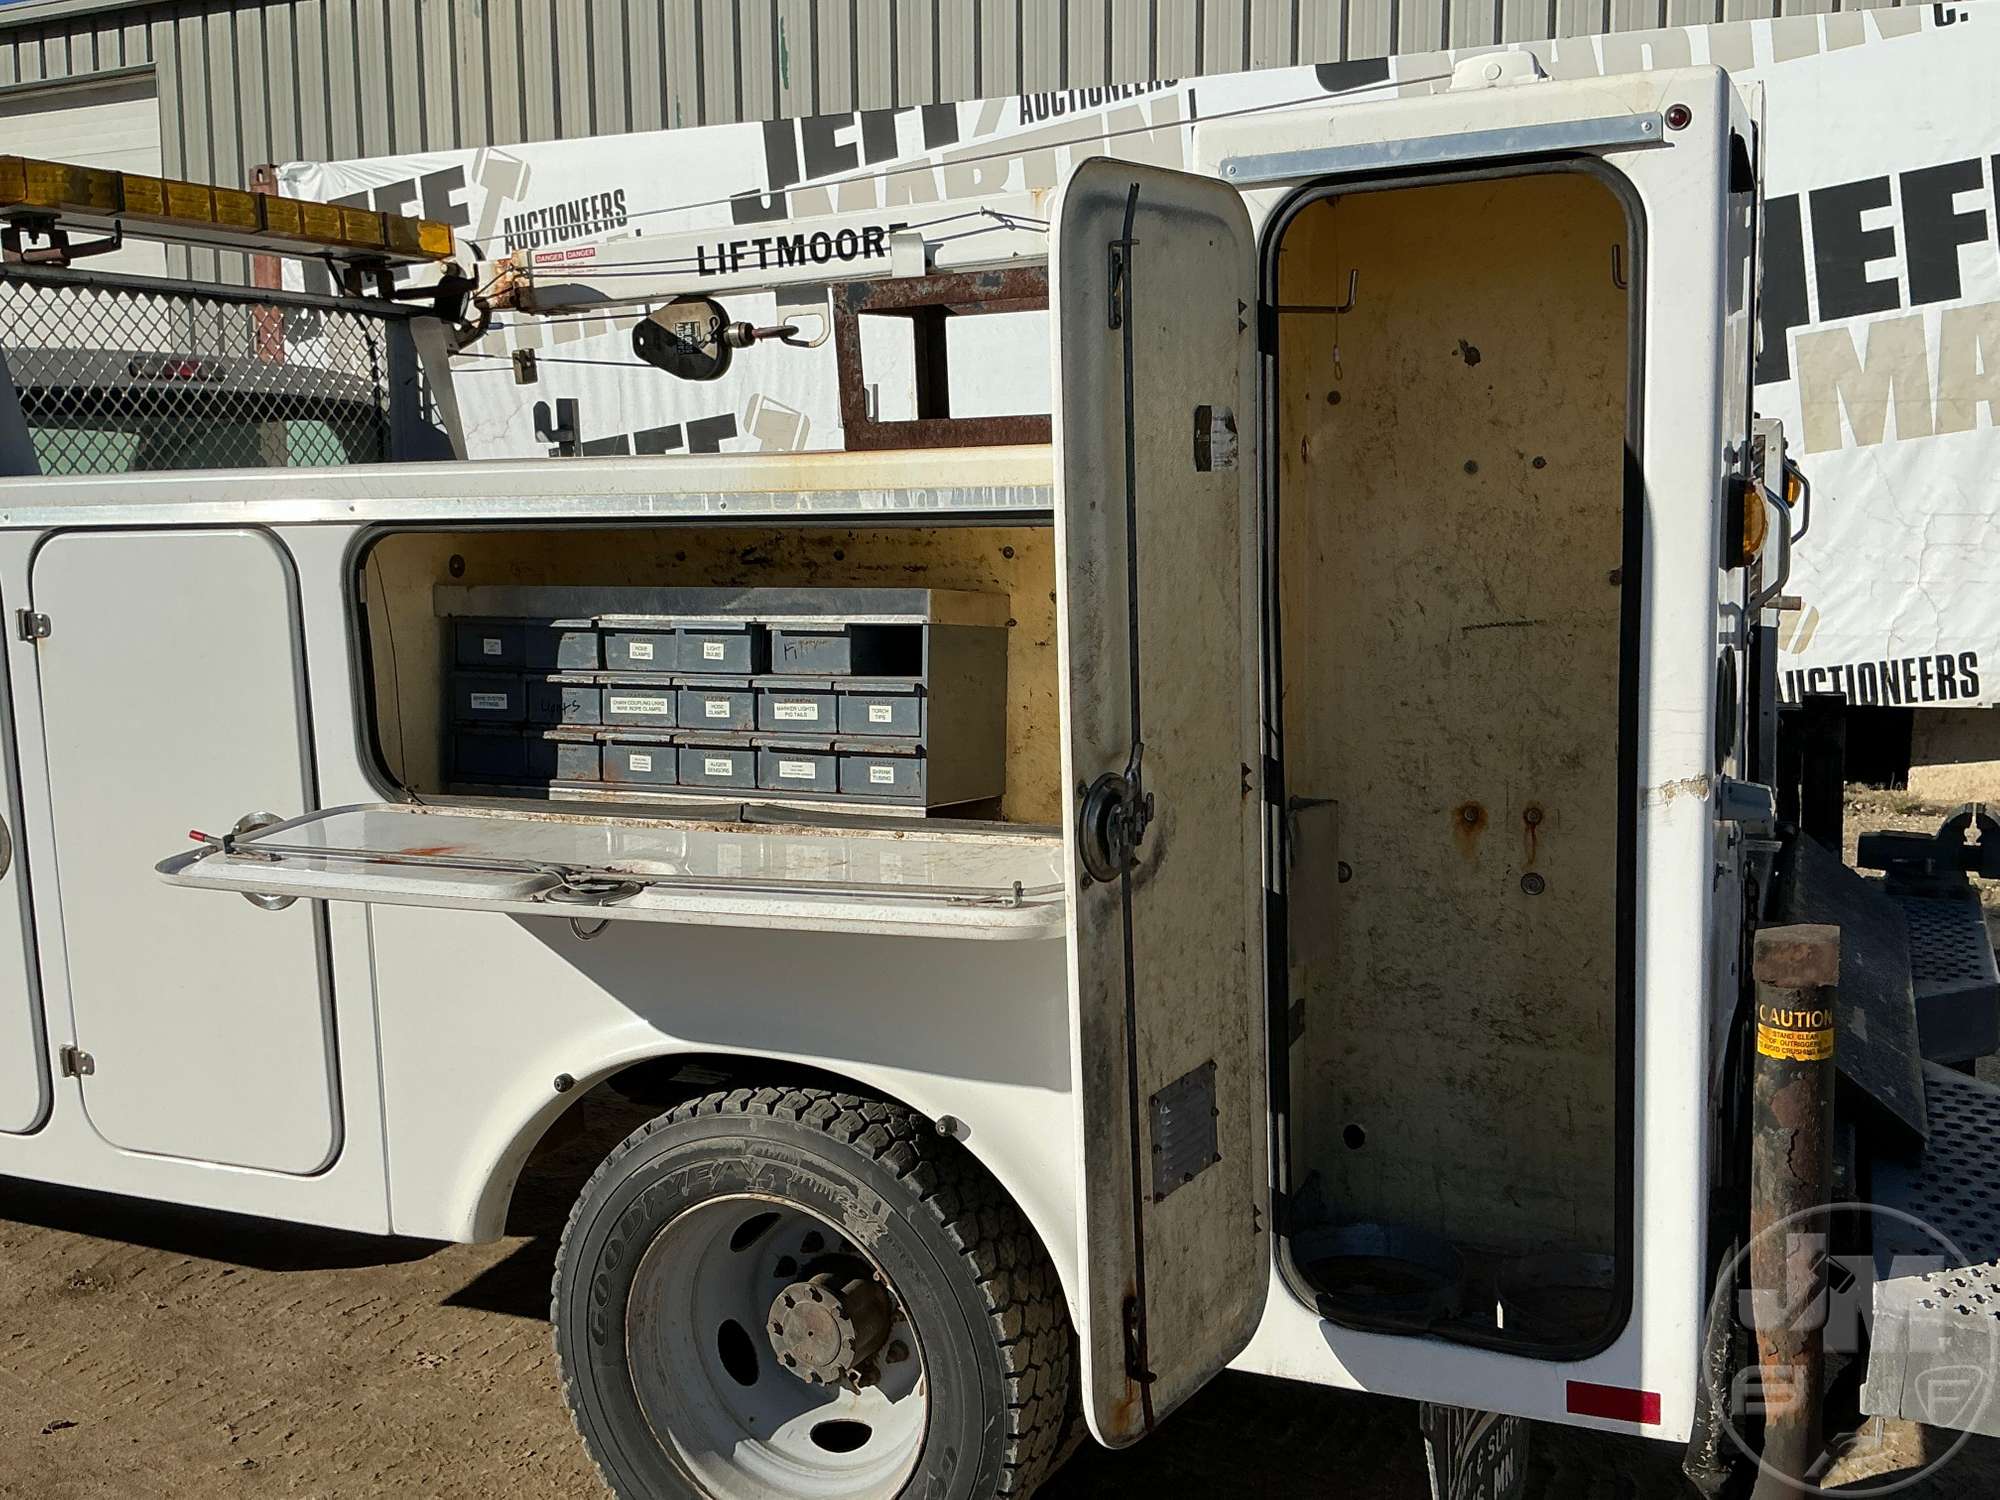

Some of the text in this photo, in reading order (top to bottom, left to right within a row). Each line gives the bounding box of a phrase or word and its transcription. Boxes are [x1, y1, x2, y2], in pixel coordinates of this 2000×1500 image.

[503, 188, 628, 255] AUCTIONEERS
[536, 254, 563, 263] DANGER
[567, 248, 594, 259] DANGER
[696, 222, 908, 277] LIFTMOOR
[1754, 154, 2000, 386] JEF
[1777, 652, 1980, 706] UCTIONEERS
[1759, 1004, 1833, 1028] CAUTION
[1773, 1030, 1795, 1040] STAND
